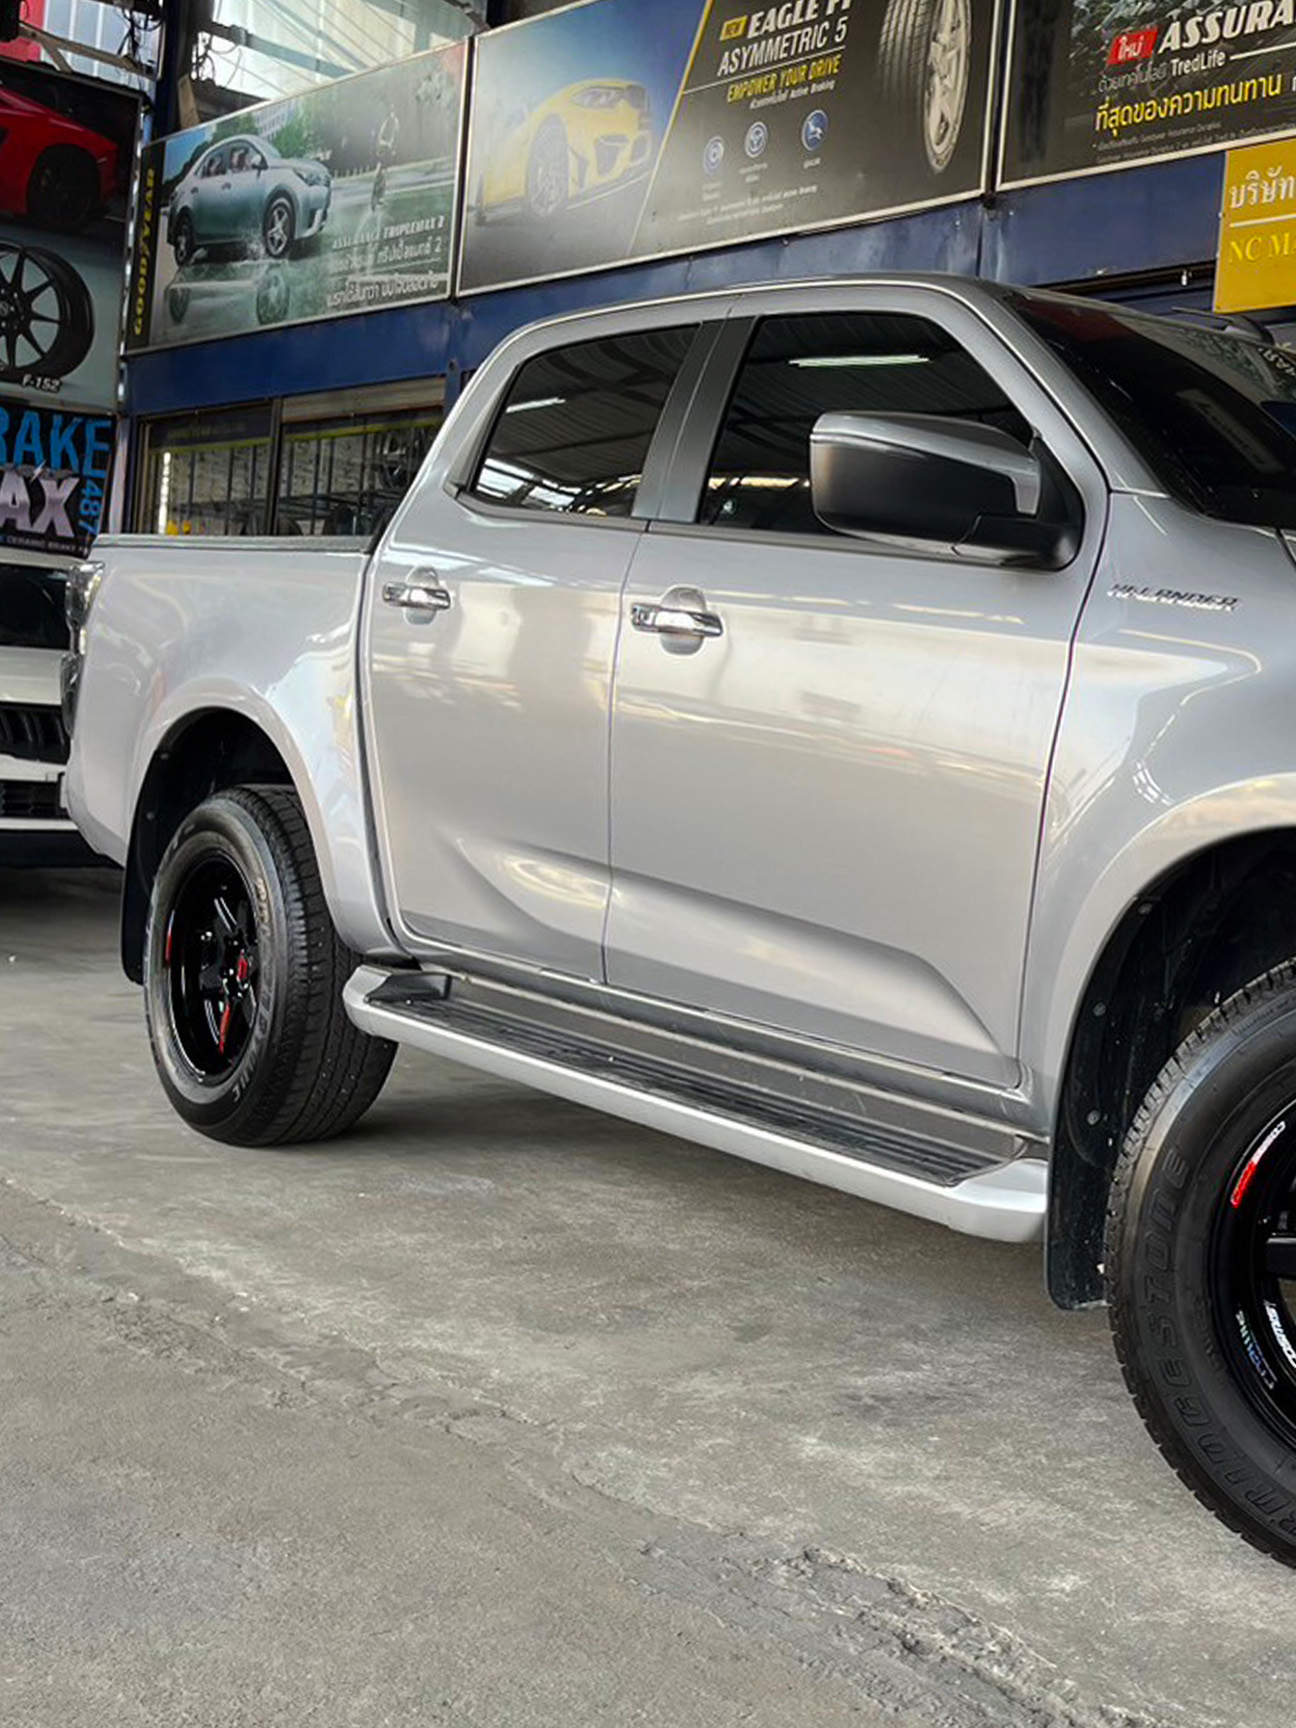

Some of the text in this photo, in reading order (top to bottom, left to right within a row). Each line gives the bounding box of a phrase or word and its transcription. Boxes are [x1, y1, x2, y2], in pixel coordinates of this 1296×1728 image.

[747, 0, 820, 39] EAGLE
[717, 15, 849, 77] ASYMMETRIC 5
[1171, 49, 1227, 79] TredLife
[1094, 71, 1283, 137] ที่สุดของความทนทาน
[1229, 162, 1295, 210] บริษัท
[1229, 238, 1262, 264] NC
[22, 374, 61, 392] F-152
